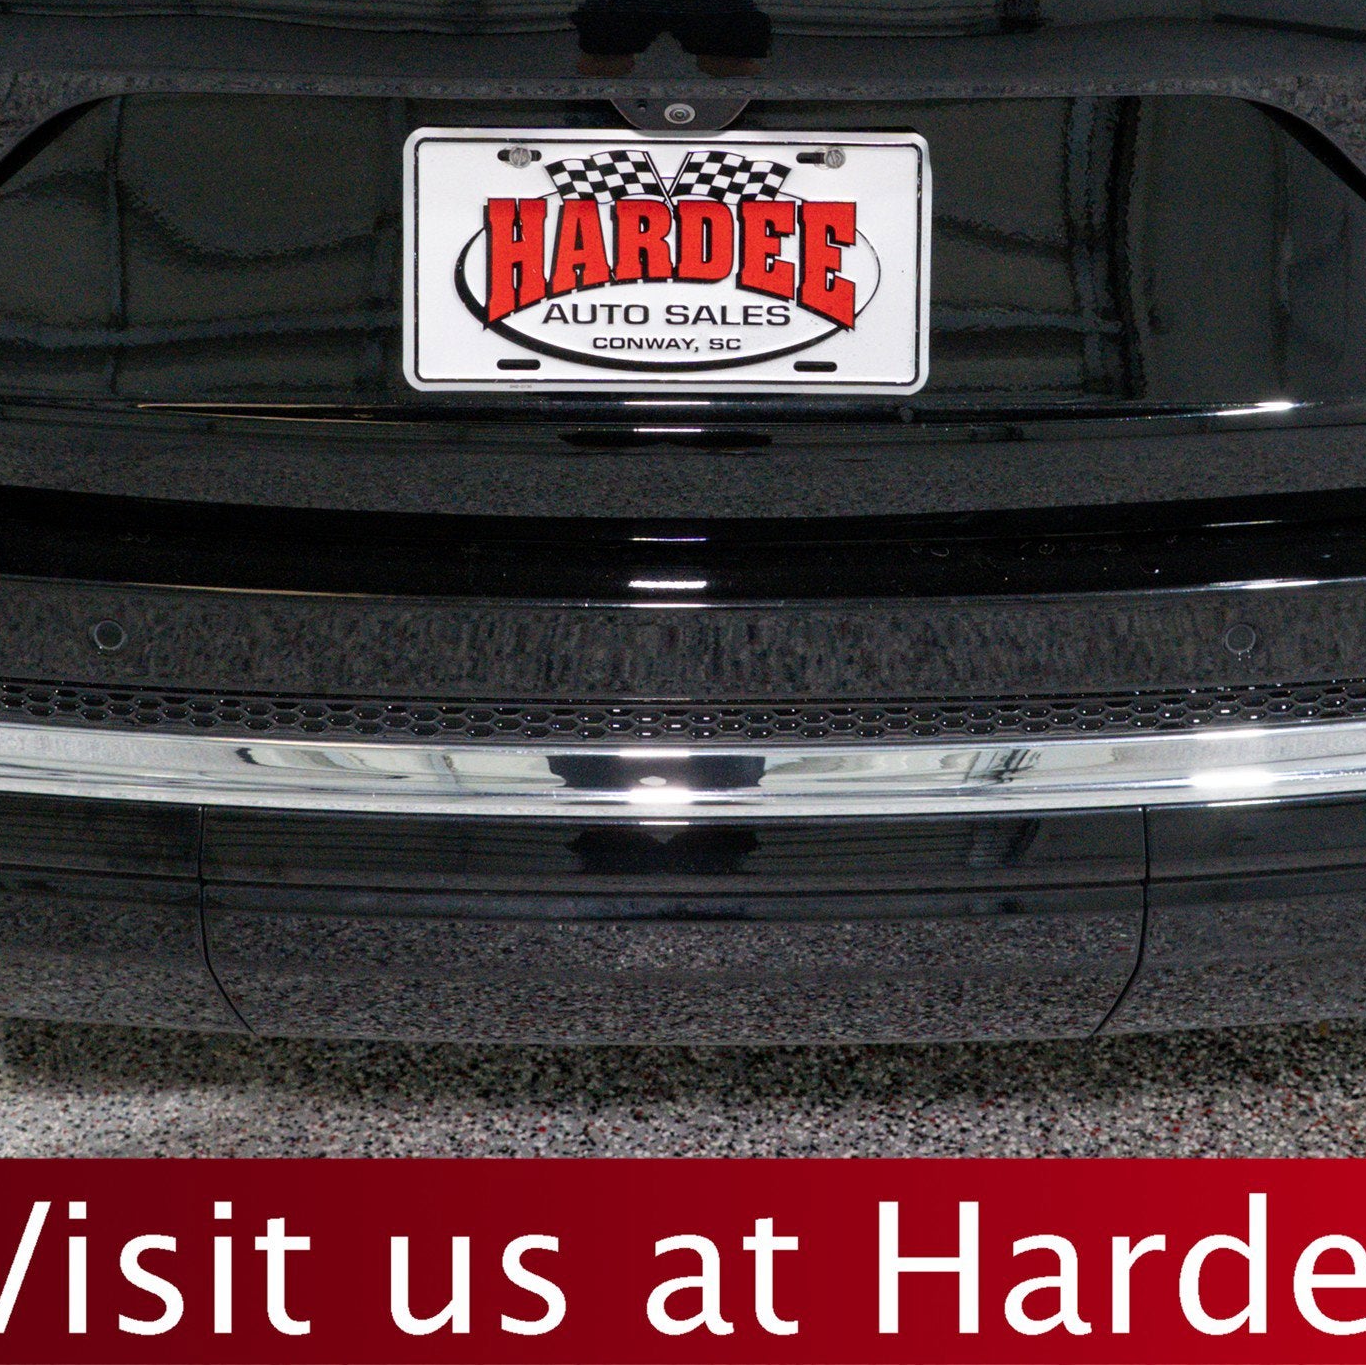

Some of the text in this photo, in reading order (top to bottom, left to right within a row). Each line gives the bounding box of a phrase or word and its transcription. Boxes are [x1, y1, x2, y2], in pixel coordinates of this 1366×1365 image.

[482, 197, 858, 332] HARDEE
[541, 302, 792, 327] AUTO SALES
[592, 336, 742, 353] CONWAY, SC
